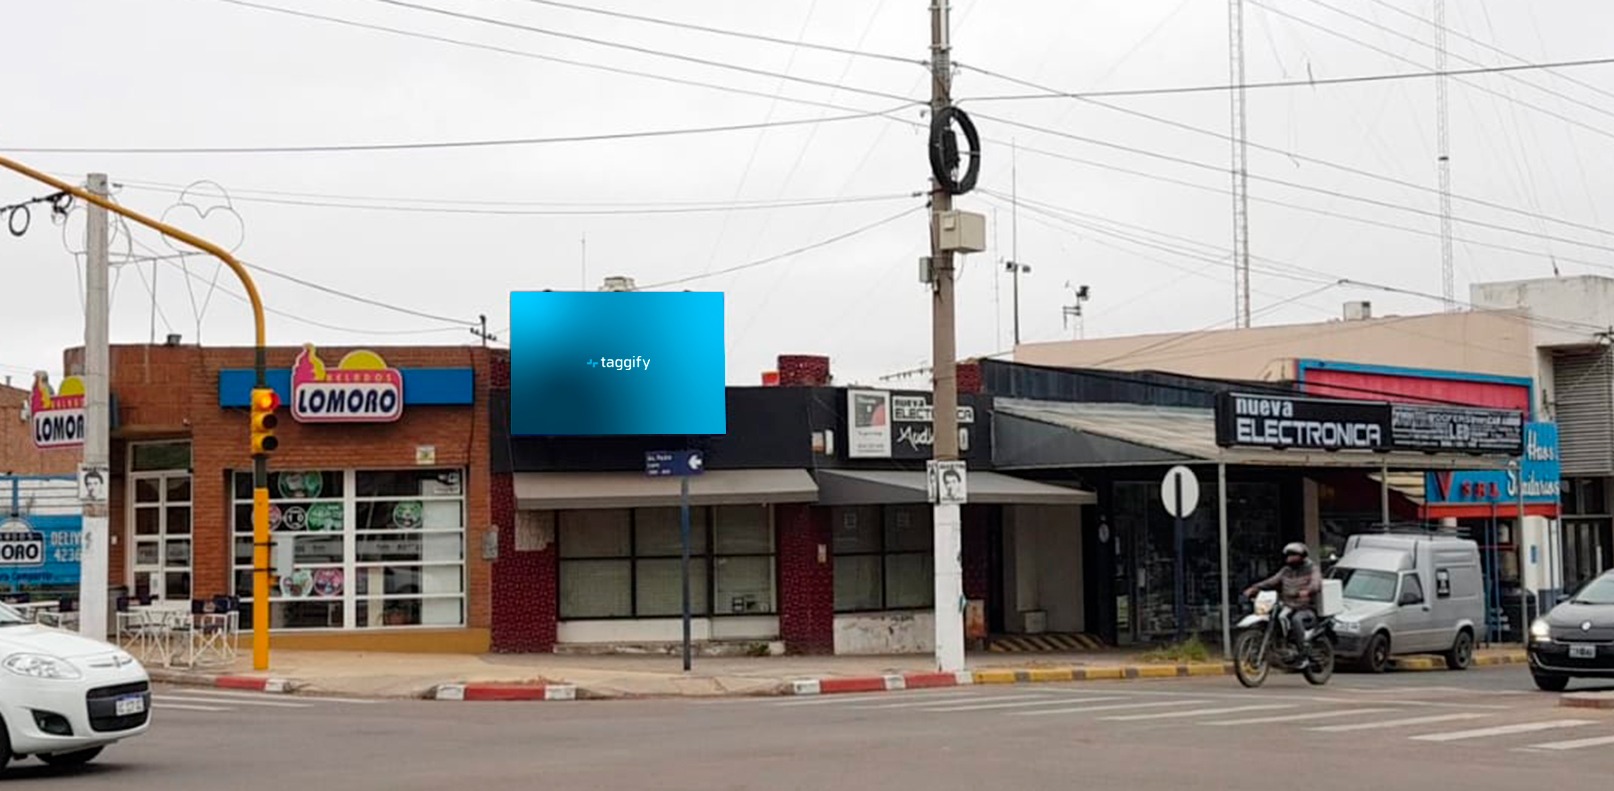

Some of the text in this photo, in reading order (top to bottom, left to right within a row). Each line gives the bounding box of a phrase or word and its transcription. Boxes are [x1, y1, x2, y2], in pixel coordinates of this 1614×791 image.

[600, 355, 651, 371] taggify
[299, 389, 396, 413] LOMORO
[1236, 398, 1293, 418] nueva
[35, 415, 85, 442] LOMOR
[1236, 417, 1381, 446] ELECTRONICA
